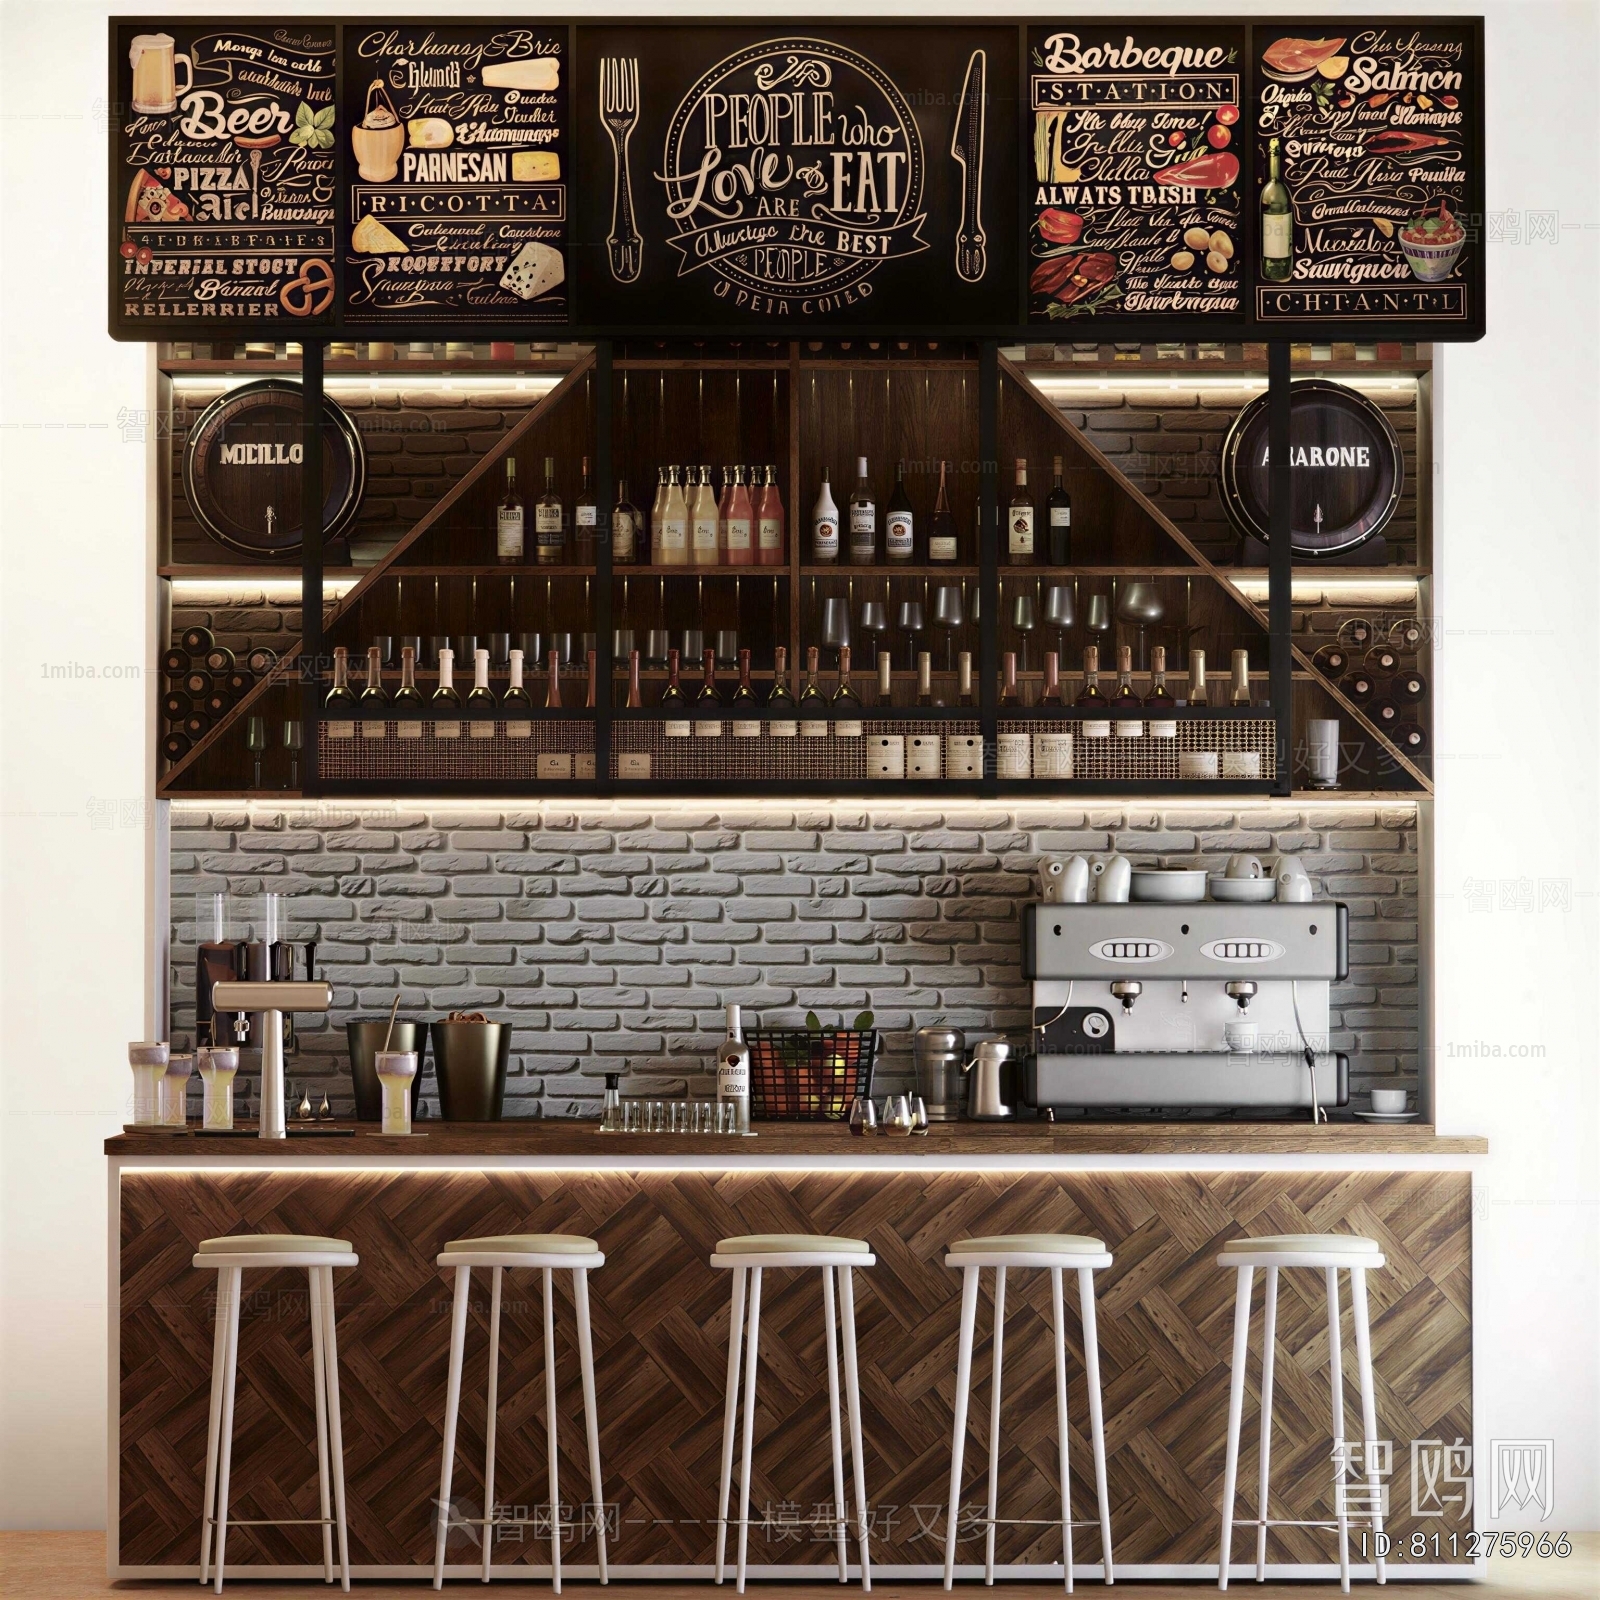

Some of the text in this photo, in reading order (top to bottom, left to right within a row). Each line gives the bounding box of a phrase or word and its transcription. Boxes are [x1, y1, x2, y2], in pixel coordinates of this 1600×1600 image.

[1044, 33, 1229, 77] Barbeque
[180, 90, 294, 140] Beer
[703, 92, 901, 149] PEOPLE who
[174, 167, 251, 191] PIZZA
[653, 147, 794, 220] Love
[830, 152, 906, 213] EAT
[757, 197, 800, 217] ARE
[836, 230, 892, 255] BEST
[1262, 446, 1370, 467] AARONE
